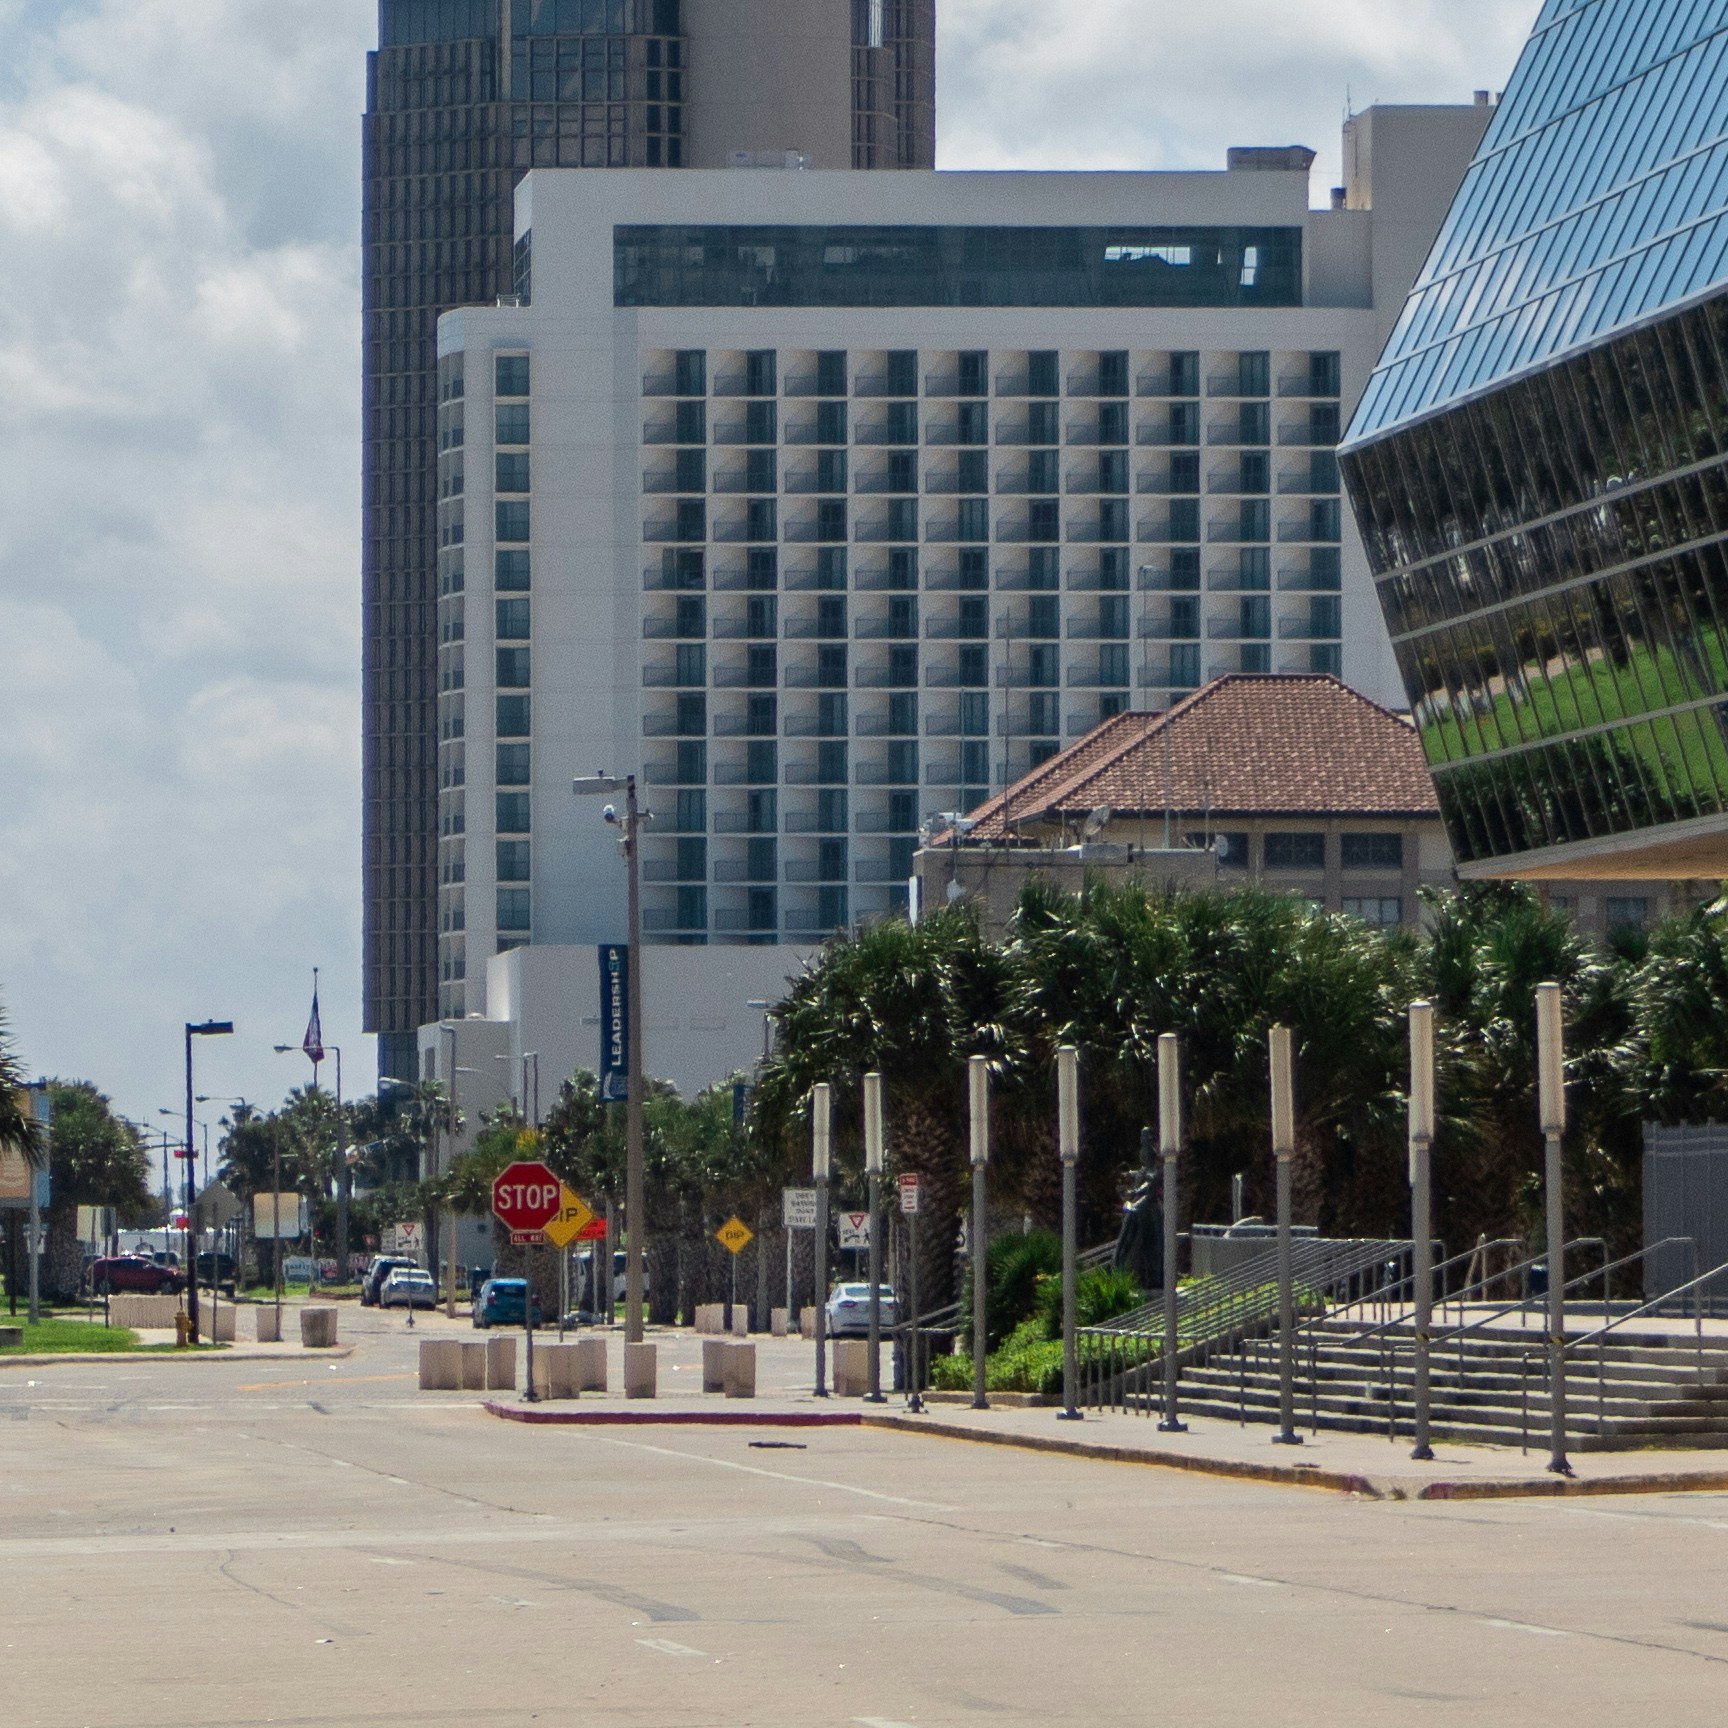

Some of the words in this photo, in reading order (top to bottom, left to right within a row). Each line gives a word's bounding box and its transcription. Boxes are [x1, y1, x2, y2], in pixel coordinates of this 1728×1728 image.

[498, 1184, 557, 1210] STOP
[552, 1208, 578, 1223] IP
[725, 1230, 745, 1240] DIP
